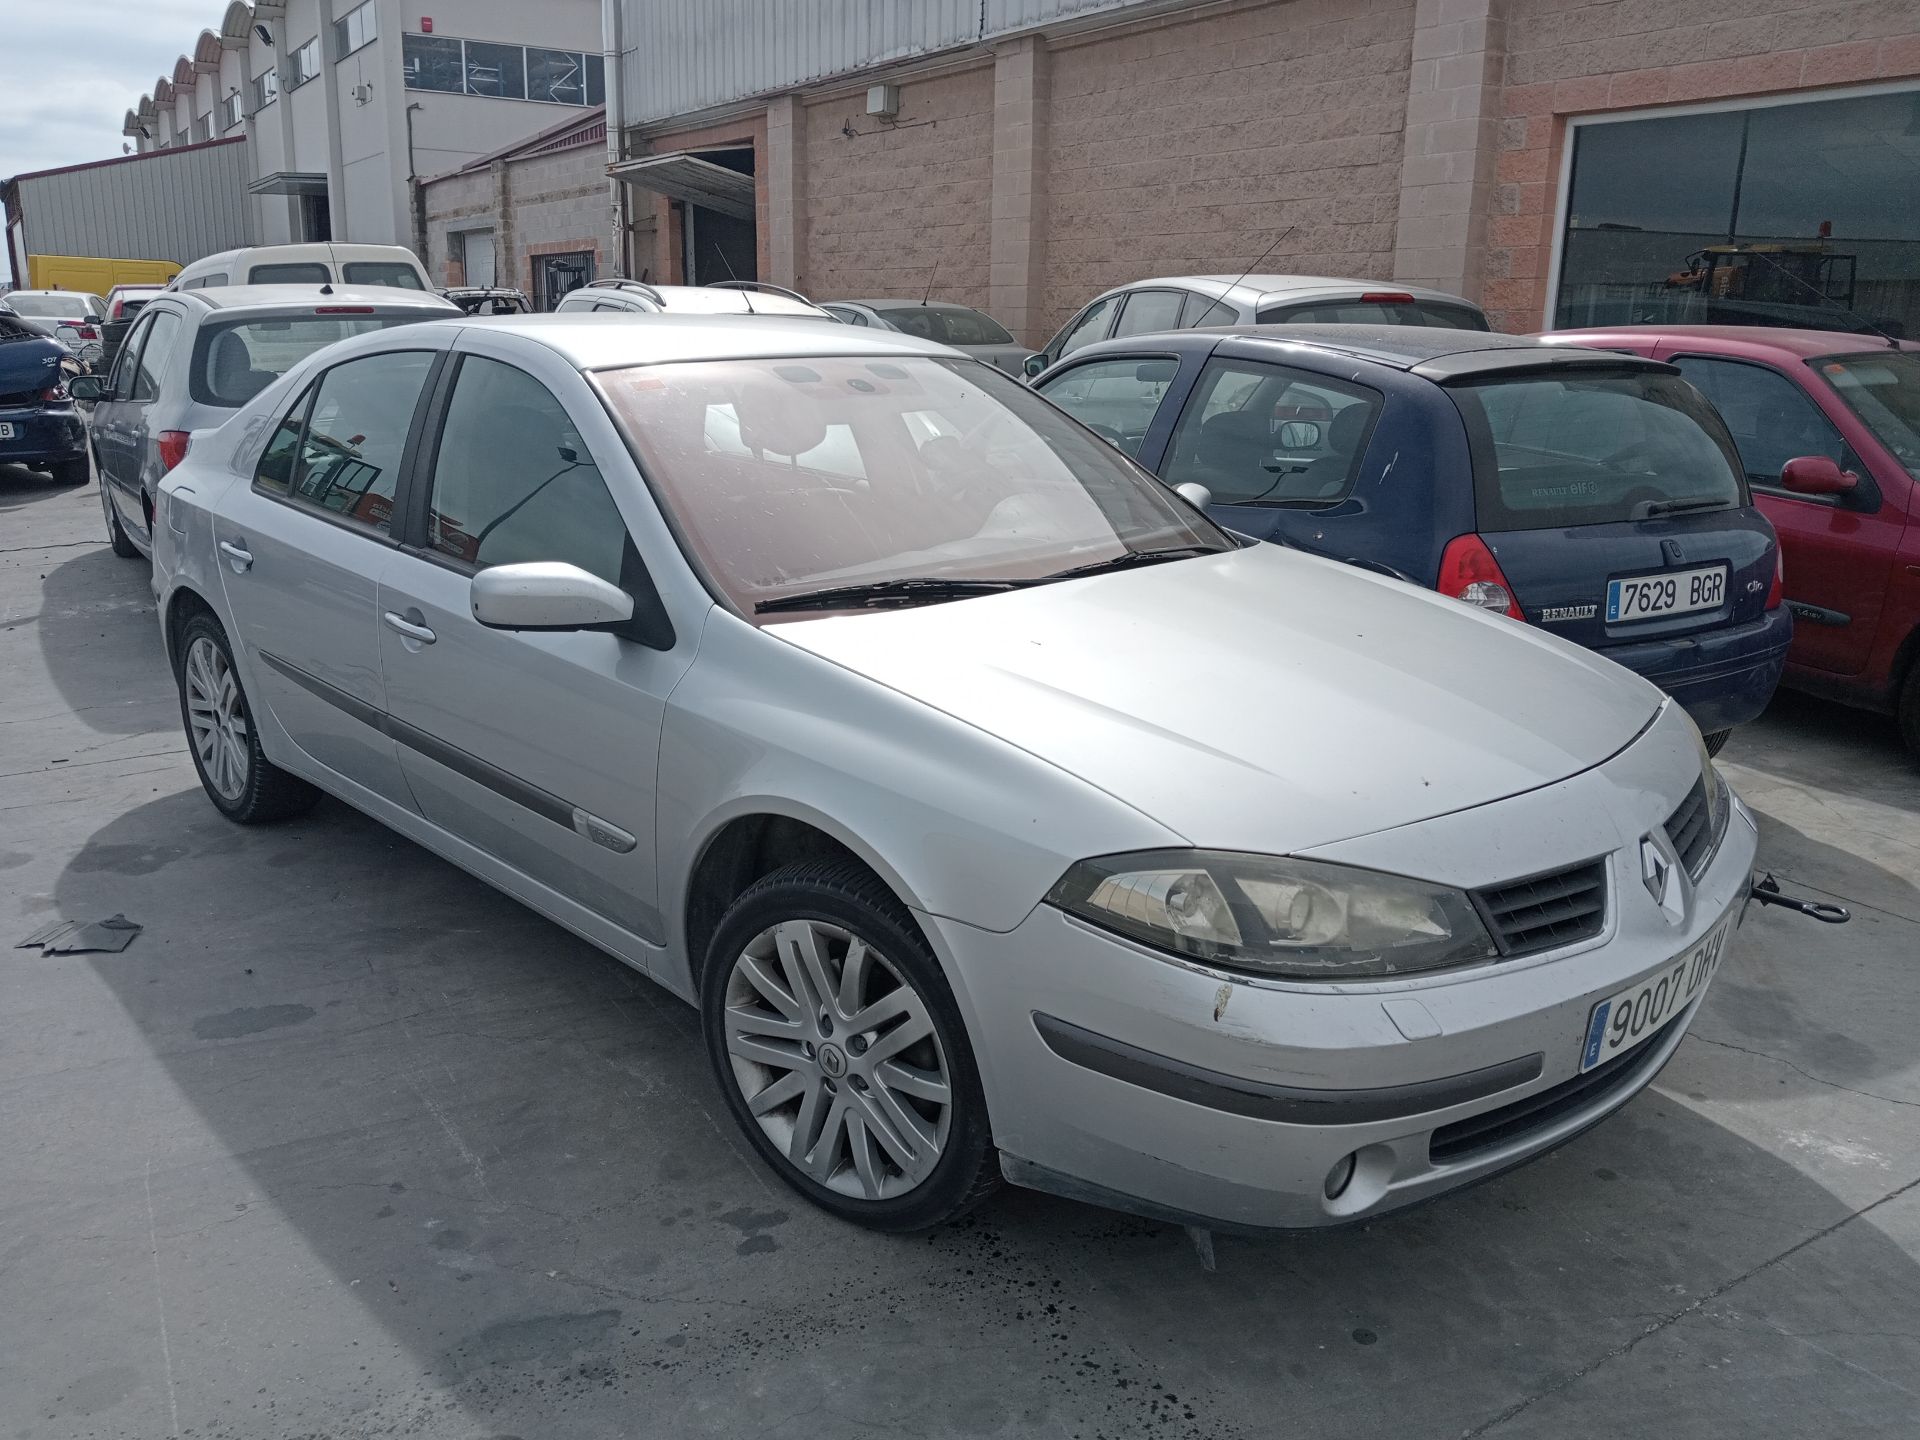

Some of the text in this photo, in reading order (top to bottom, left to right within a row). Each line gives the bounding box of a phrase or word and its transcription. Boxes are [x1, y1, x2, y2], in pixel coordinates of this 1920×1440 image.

[42, 356, 57, 364] 307
[1531, 487, 1568, 497] RENAULT
[1623, 572, 1723, 615] 7629 BGR
[1541, 604, 1598, 622] RENAULT
[1610, 605, 1617, 615] E
[1609, 961, 1686, 1048] 9007
[1590, 1041, 1598, 1057] E
